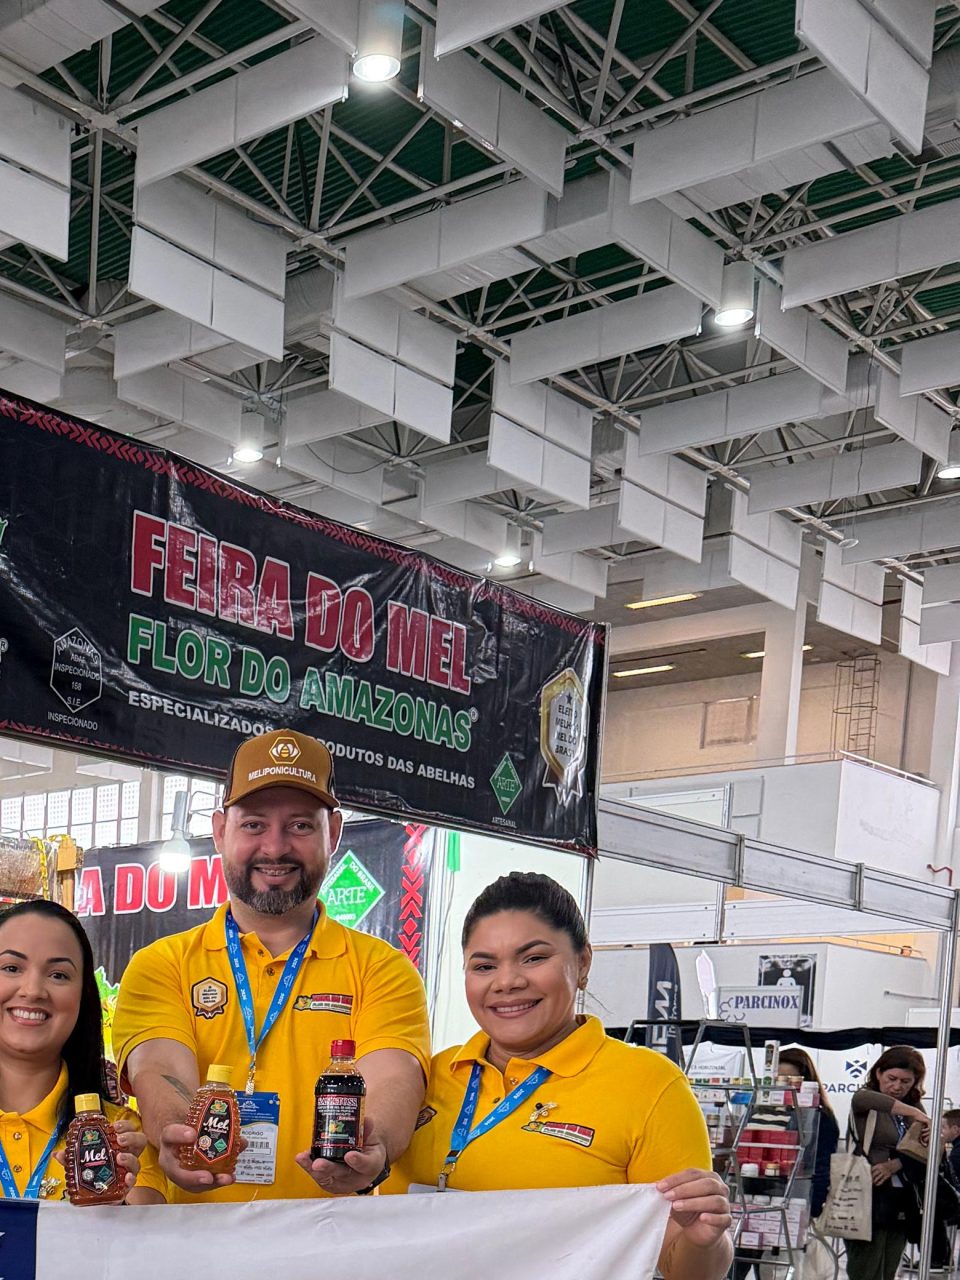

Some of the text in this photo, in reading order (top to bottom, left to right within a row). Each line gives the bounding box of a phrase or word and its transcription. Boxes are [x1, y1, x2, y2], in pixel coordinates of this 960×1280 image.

[130, 509, 471, 695] FEIRA DO MEL
[127, 612, 232, 690] FLOR
[240, 646, 291, 704] DO
[47, 711, 98, 731] INSPECIONADO
[128, 690, 274, 738] ESPECIALIZADOS
[317, 738, 384, 767] ODUTOS
[387, 755, 415, 774] DAS
[417, 762, 475, 789] ABELHAS
[248, 766, 317, 783] MELIPONICULTURA
[113, 861, 178, 914] DO
[327, 886, 366, 906] ARTE
[734, 995, 799, 1009] PARCINOX
[203, 1117, 230, 1131] Mel
[81, 1148, 108, 1163] Mel
